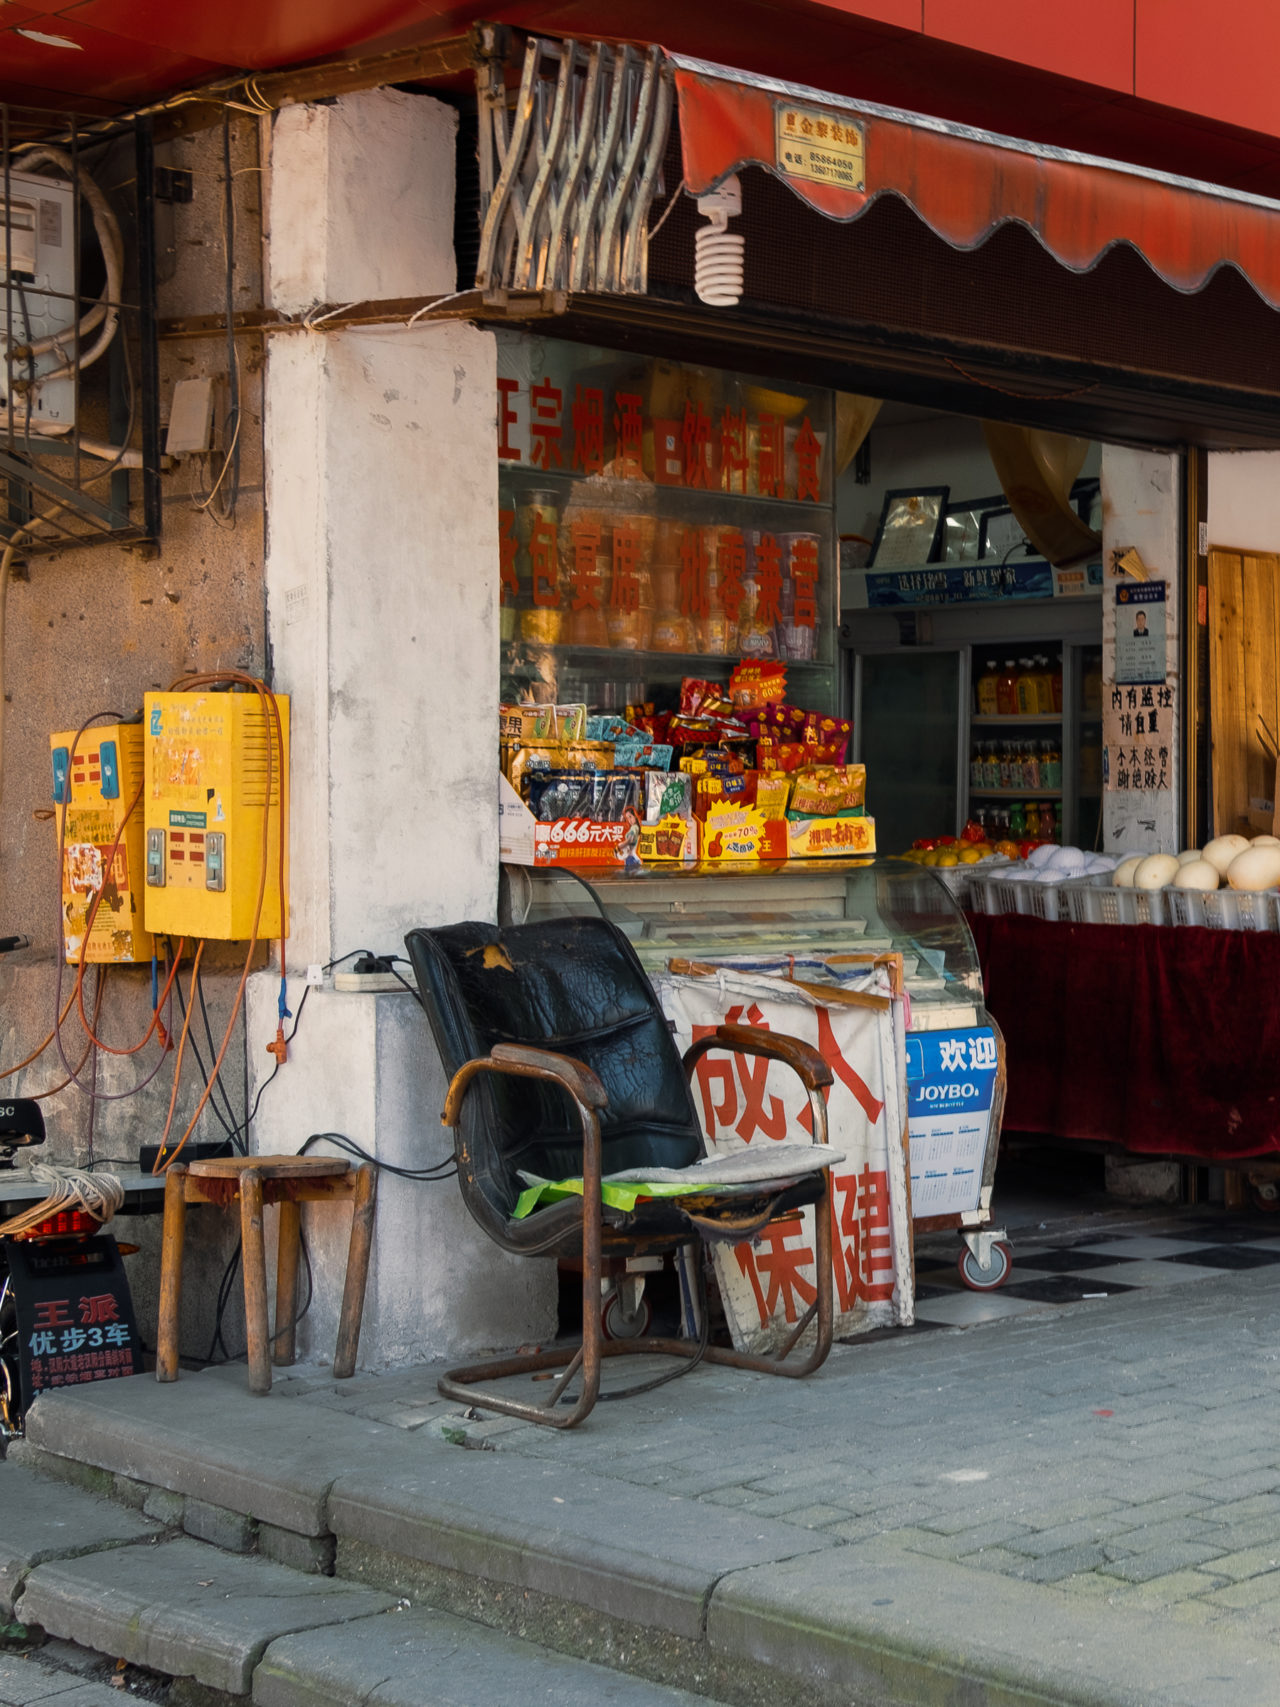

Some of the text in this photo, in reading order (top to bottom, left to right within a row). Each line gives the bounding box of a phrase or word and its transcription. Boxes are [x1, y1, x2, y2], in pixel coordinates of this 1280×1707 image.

[497, 377, 822, 503] 正宗烟酒 饮料副食
[679, 527, 819, 630] 批零兼营
[1111, 686, 1173, 710] 内有监控
[1118, 708, 1160, 736] 请自重
[692, 1001, 883, 1143] 成人
[939, 1037, 998, 1072] 欢迎
[916, 1083, 975, 1102] JOYBO
[33, 1293, 120, 1329] 王派
[28, 1323, 131, 1357] 优步3车
